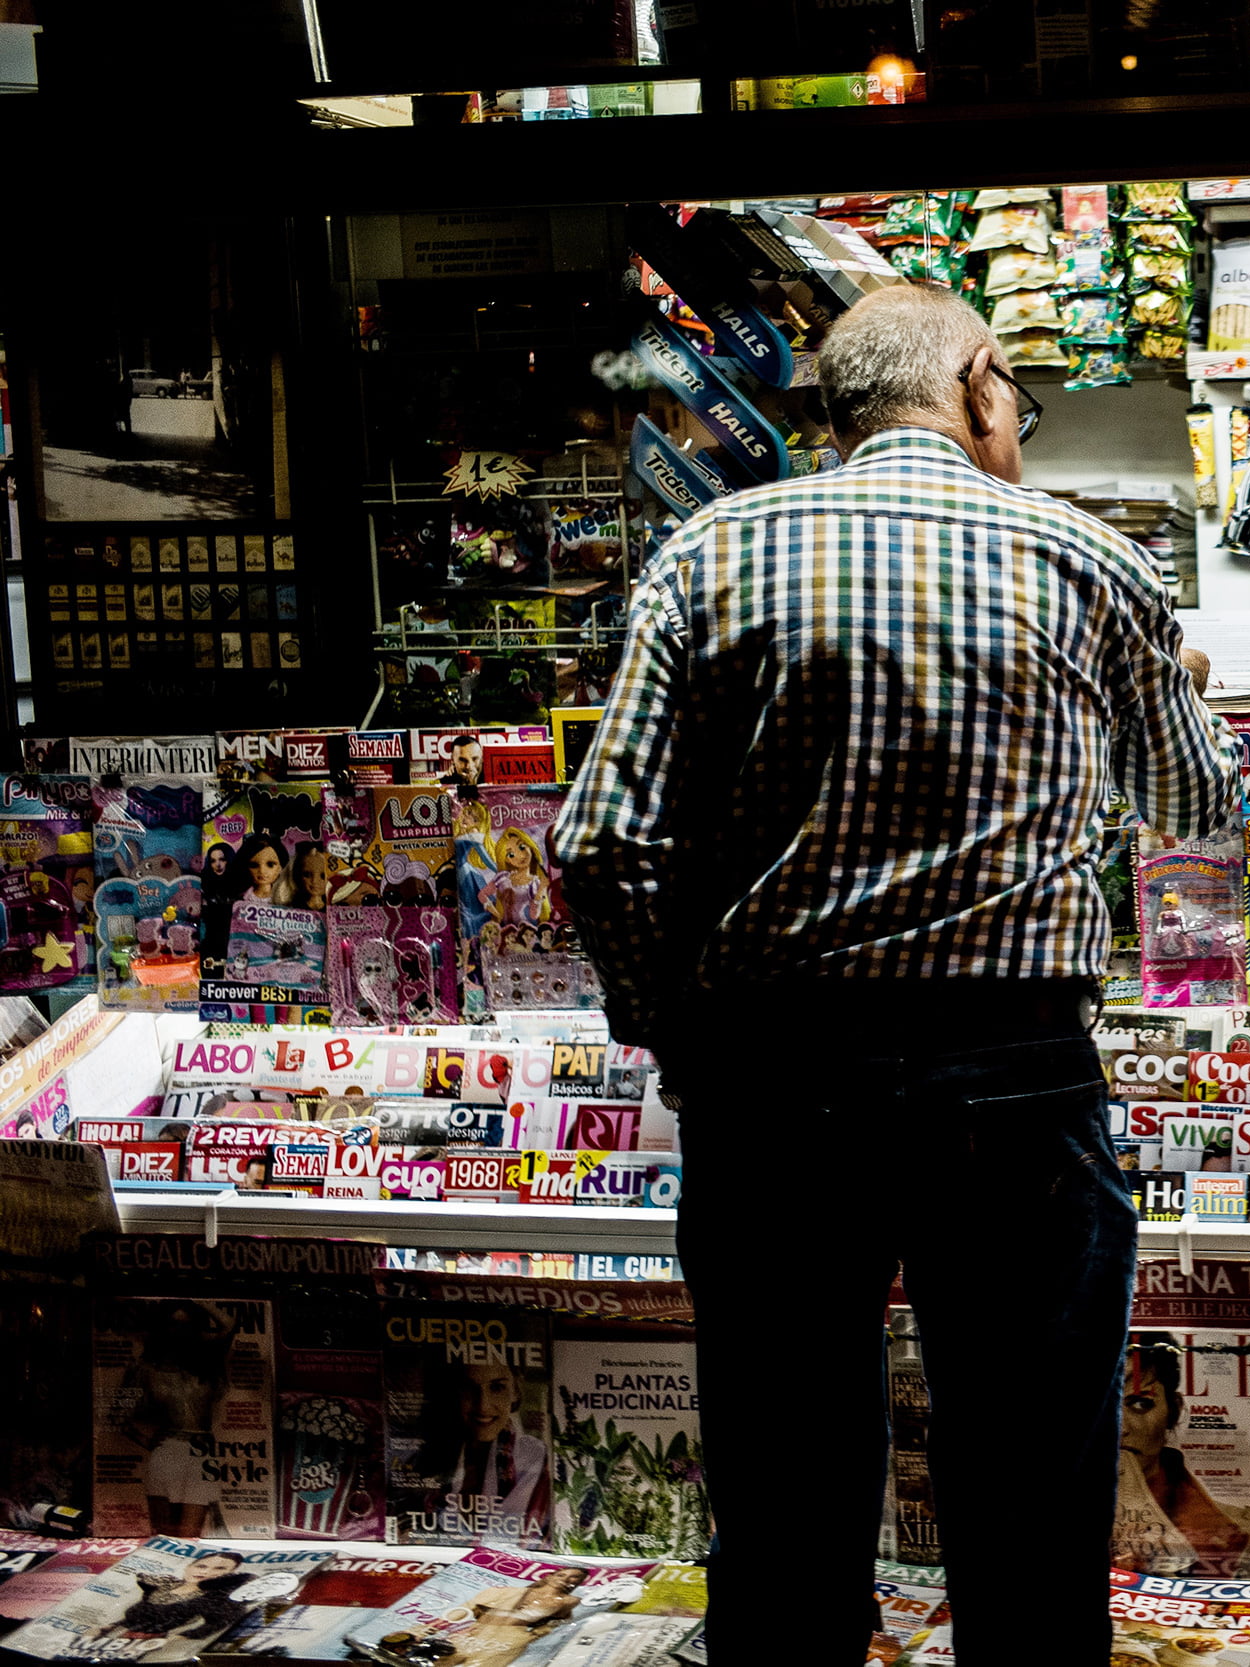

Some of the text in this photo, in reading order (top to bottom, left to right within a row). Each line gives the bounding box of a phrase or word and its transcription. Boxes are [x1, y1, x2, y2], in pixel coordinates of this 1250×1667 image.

[713, 301, 769, 358] HALLS
[640, 328, 704, 393] Trident
[708, 402, 767, 460] HALLS
[287, 743, 322, 759] DIEZ
[348, 737, 404, 758] SEMANA
[288, 757, 326, 768] MINUTOS
[207, 984, 259, 1000] Forever
[261, 984, 293, 1001] BEST
[1115, 1082, 1159, 1095] LECTURAS
[81, 1123, 140, 1141] ¡HOLA!
[123, 1153, 174, 1174] DIEZ
[449, 1159, 499, 1189] 1968
[328, 1186, 364, 1199] REINA
[1193, 1180, 1245, 1196] integral
[220, 1241, 386, 1279] COSMOPOLITAN
[385, 1318, 508, 1343] CUERPO
[445, 1341, 545, 1367] MENTE
[594, 1374, 691, 1391] PLANTAS
[1190, 1406, 1228, 1416] MODA
[190, 1439, 267, 1460] Street
[202, 1460, 269, 1487] Style
[300, 1460, 332, 1480] POP
[291, 1472, 337, 1492] CORN
[446, 1493, 505, 1514] SUBE
[405, 1509, 544, 1538] TU ENERGÍA
